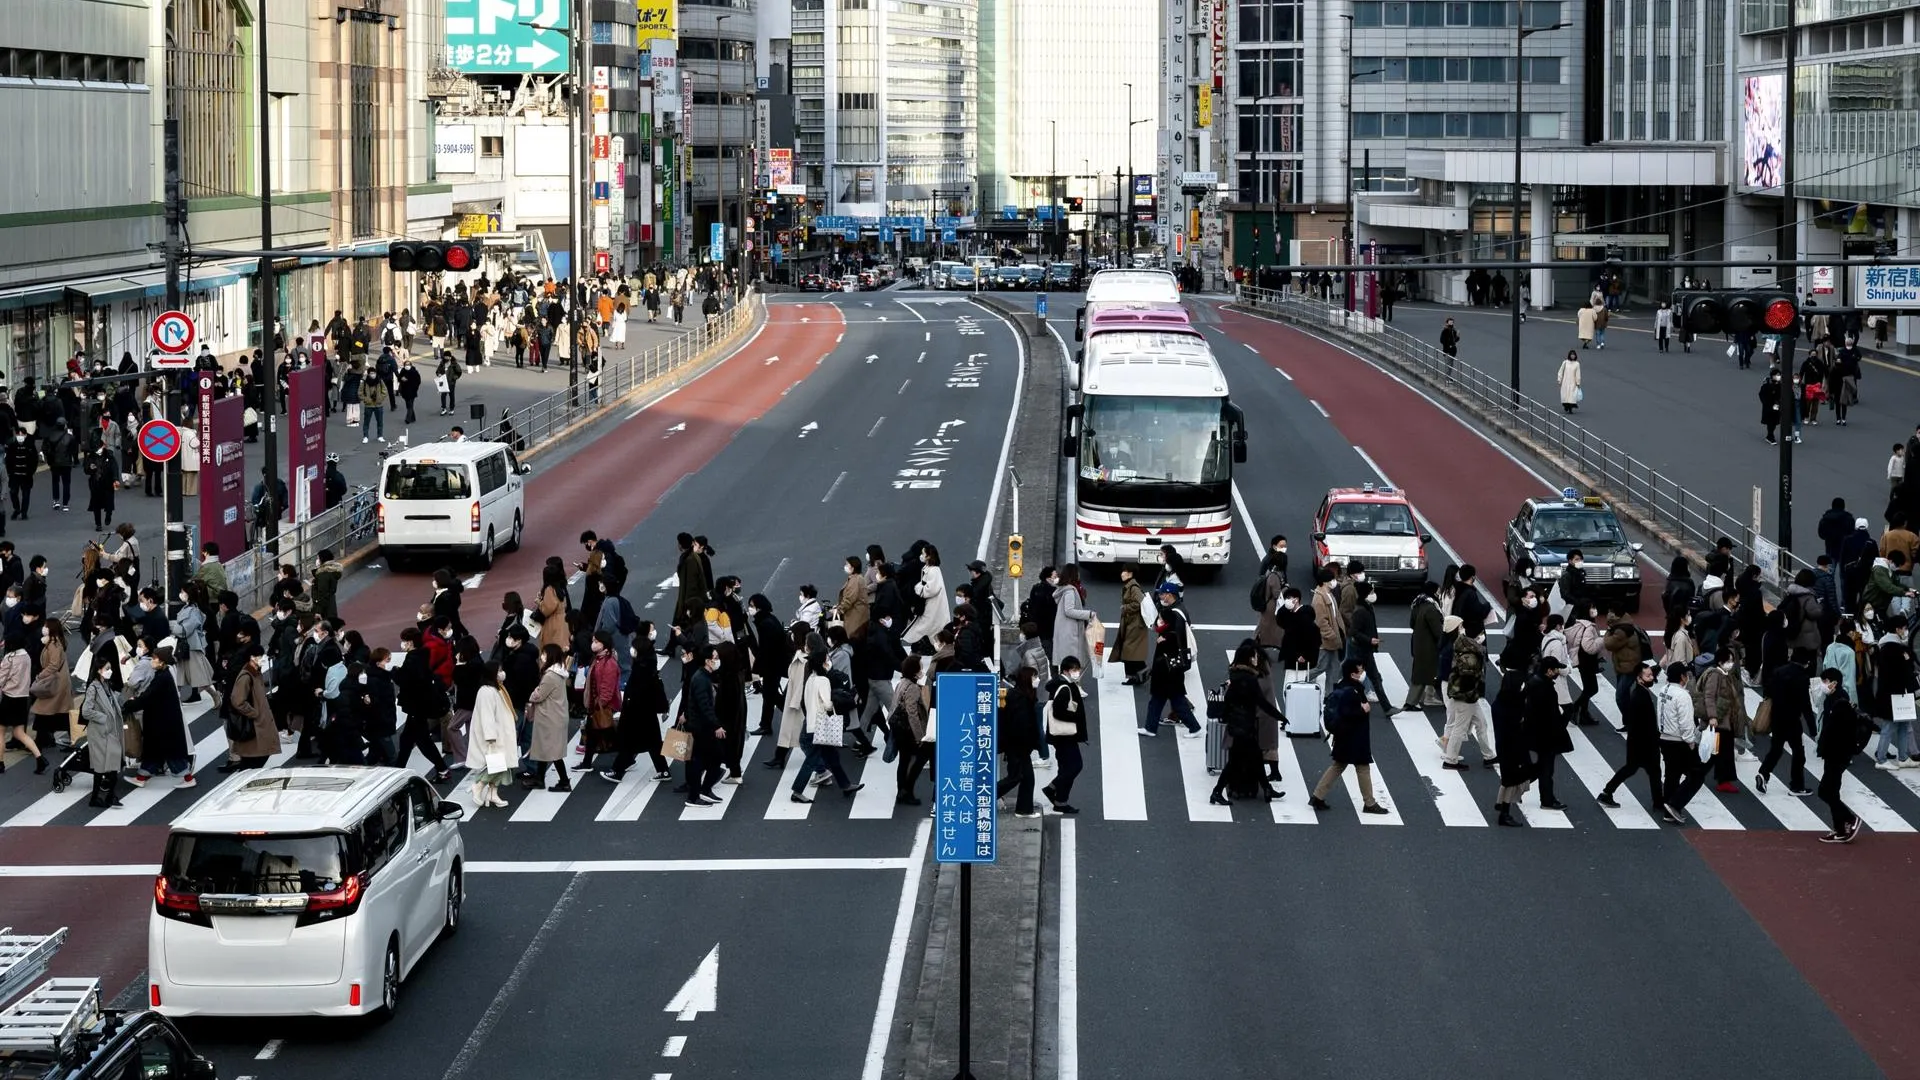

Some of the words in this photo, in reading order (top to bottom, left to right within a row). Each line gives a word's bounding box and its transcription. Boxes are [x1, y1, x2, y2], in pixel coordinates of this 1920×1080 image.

[444, 0, 559, 36] ニトリ
[637, 7, 667, 22] スポーツ
[434, 144, 473, 154] 03-5904-5995
[664, 165, 672, 220] レイクALSA
[1173, 154, 1183, 233] 安心お宿
[1866, 289, 1916, 302] Shinjuku
[202, 394, 210, 464] 新宿駅南口周辺案内
[892, 439, 960, 489] バスタ新宿
[959, 712, 974, 824] バスタ新宿へは
[977, 682, 992, 856] 一般車・貸切バス・大型貨物車は
[941, 777, 957, 857] 入れません
